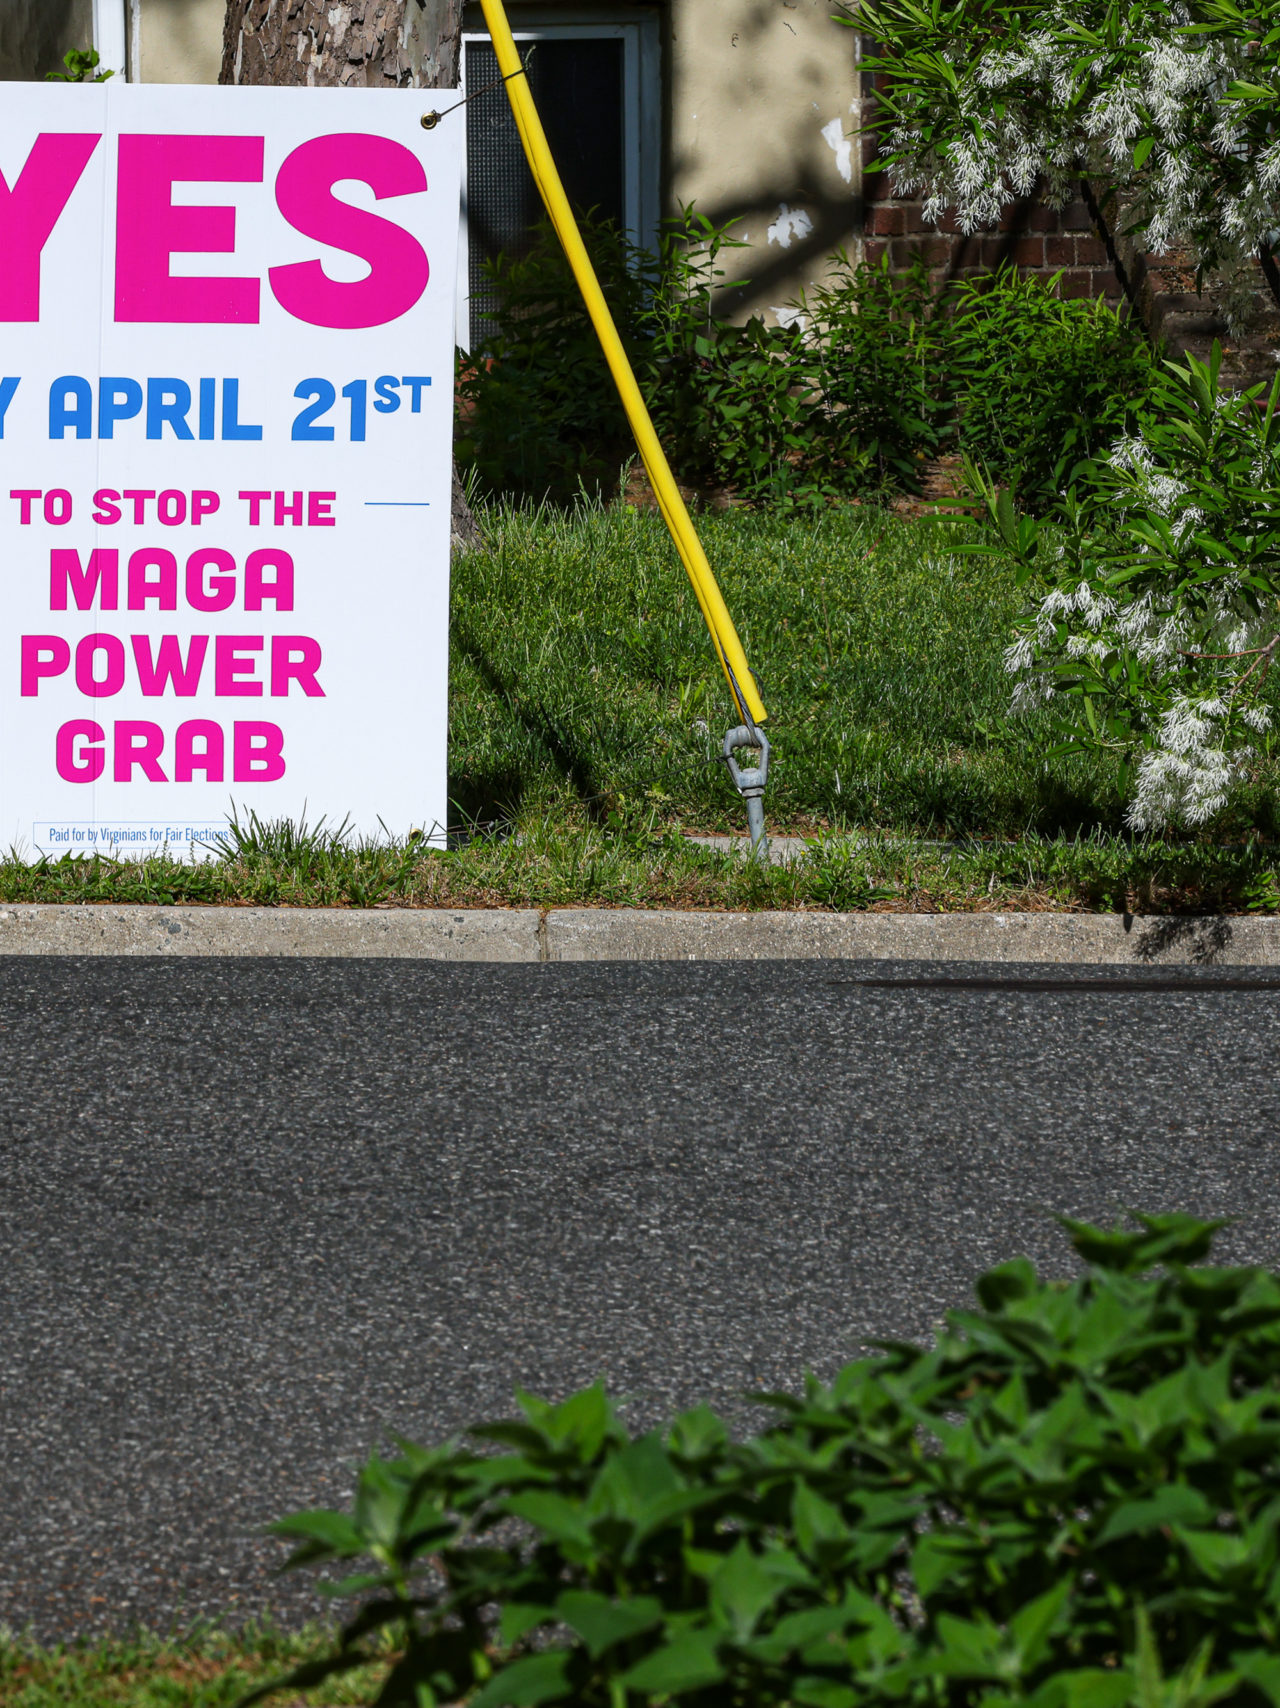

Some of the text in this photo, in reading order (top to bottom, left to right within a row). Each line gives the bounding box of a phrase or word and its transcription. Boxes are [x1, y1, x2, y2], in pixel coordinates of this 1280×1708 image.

[48, 376, 263, 441] APRIL
[291, 376, 433, 442] 21ST
[10, 489, 337, 527] TO STOP THE
[50, 548, 294, 612] MAGA
[21, 633, 326, 697] POWER
[56, 719, 286, 783] GRAB
[49, 827, 229, 844] Paid for by Virginians for Fair Elections
